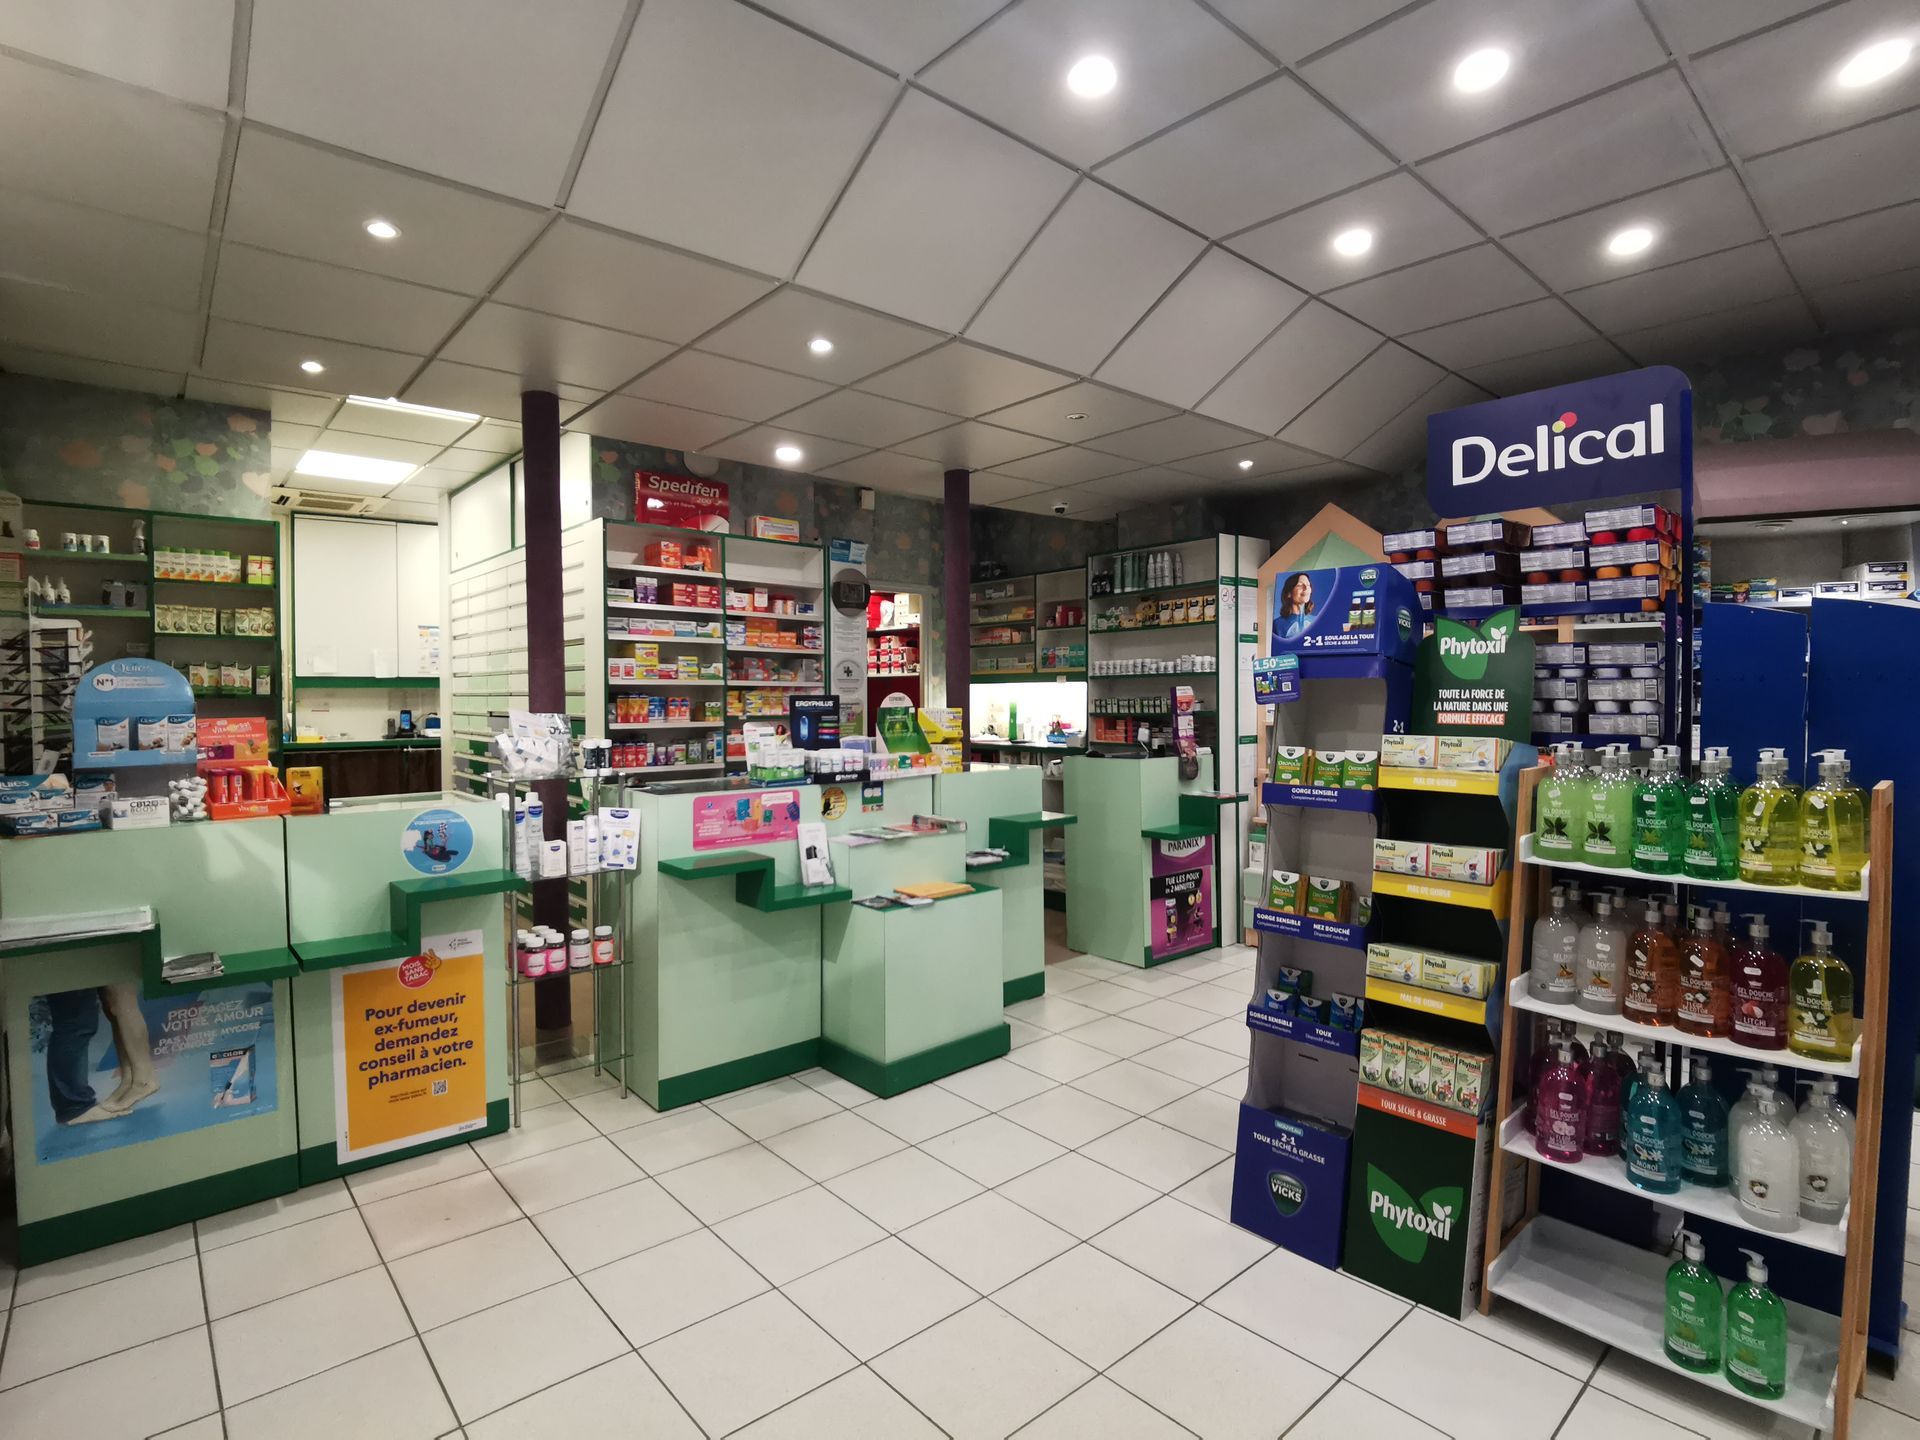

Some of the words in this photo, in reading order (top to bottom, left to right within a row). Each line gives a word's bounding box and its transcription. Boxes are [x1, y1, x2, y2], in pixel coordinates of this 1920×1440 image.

[1452, 403, 1665, 486] Delical
[648, 475, 720, 498] Spedifen
[1440, 634, 1506, 659] Phytoxil
[1438, 689, 1460, 699] TOUTE
[1461, 689, 1471, 699] LA
[1471, 689, 1494, 699] FORCE
[1495, 689, 1505, 699] DE
[1433, 702, 1443, 711] LA
[1443, 702, 1471, 711] NATURE
[1472, 702, 1492, 711] DANS
[1493, 702, 1509, 712] UNE
[1438, 713, 1471, 723] FORMULE
[1471, 713, 1504, 724] EFFICACE
[1291, 787, 1311, 795] GORGE
[1312, 788, 1338, 797] SENSIBLE
[1168, 837, 1200, 852] PARANIX
[1177, 874, 1186, 884] LES
[1256, 913, 1276, 922] GORGE
[1276, 915, 1302, 927] SENSIBLE
[1313, 923, 1325, 931] NEZ
[1325, 925, 1351, 936] BOUCHÉ
[402, 961, 421, 971] MOIS
[405, 967, 425, 977] SANS
[404, 971, 429, 982] TABAC
[1749, 989, 1774, 999] DOUCHE
[168, 1000, 244, 1020] PROPAGEZ
[365, 1006, 403, 1021] Pour
[407, 992, 467, 1014] devenir
[1807, 997, 1833, 1008] DOUCHE
[161, 1017, 209, 1033] VOTRE
[214, 1006, 264, 1024] AMOUR
[374, 1012, 458, 1036] ex-fumeur,
[1249, 1010, 1268, 1020] GORGE
[1268, 1014, 1293, 1028] SENSIBLE
[1743, 1018, 1766, 1027] LITCHI
[374, 1028, 458, 1052] demandez
[1315, 1027, 1332, 1038] TOUX
[359, 1048, 416, 1072] conseil
[420, 1046, 429, 1059] à
[433, 1040, 474, 1056] votre
[368, 1057, 467, 1090] pharmacien.
[1381, 1098, 1397, 1111] TOUX
[1422, 1110, 1447, 1126] GRASSE
[1253, 1132, 1271, 1144] TOUX
[1299, 1149, 1325, 1165] GRASSE
[1271, 1183, 1302, 1203] VICKS
[1370, 1190, 1452, 1241] Phytoxil
